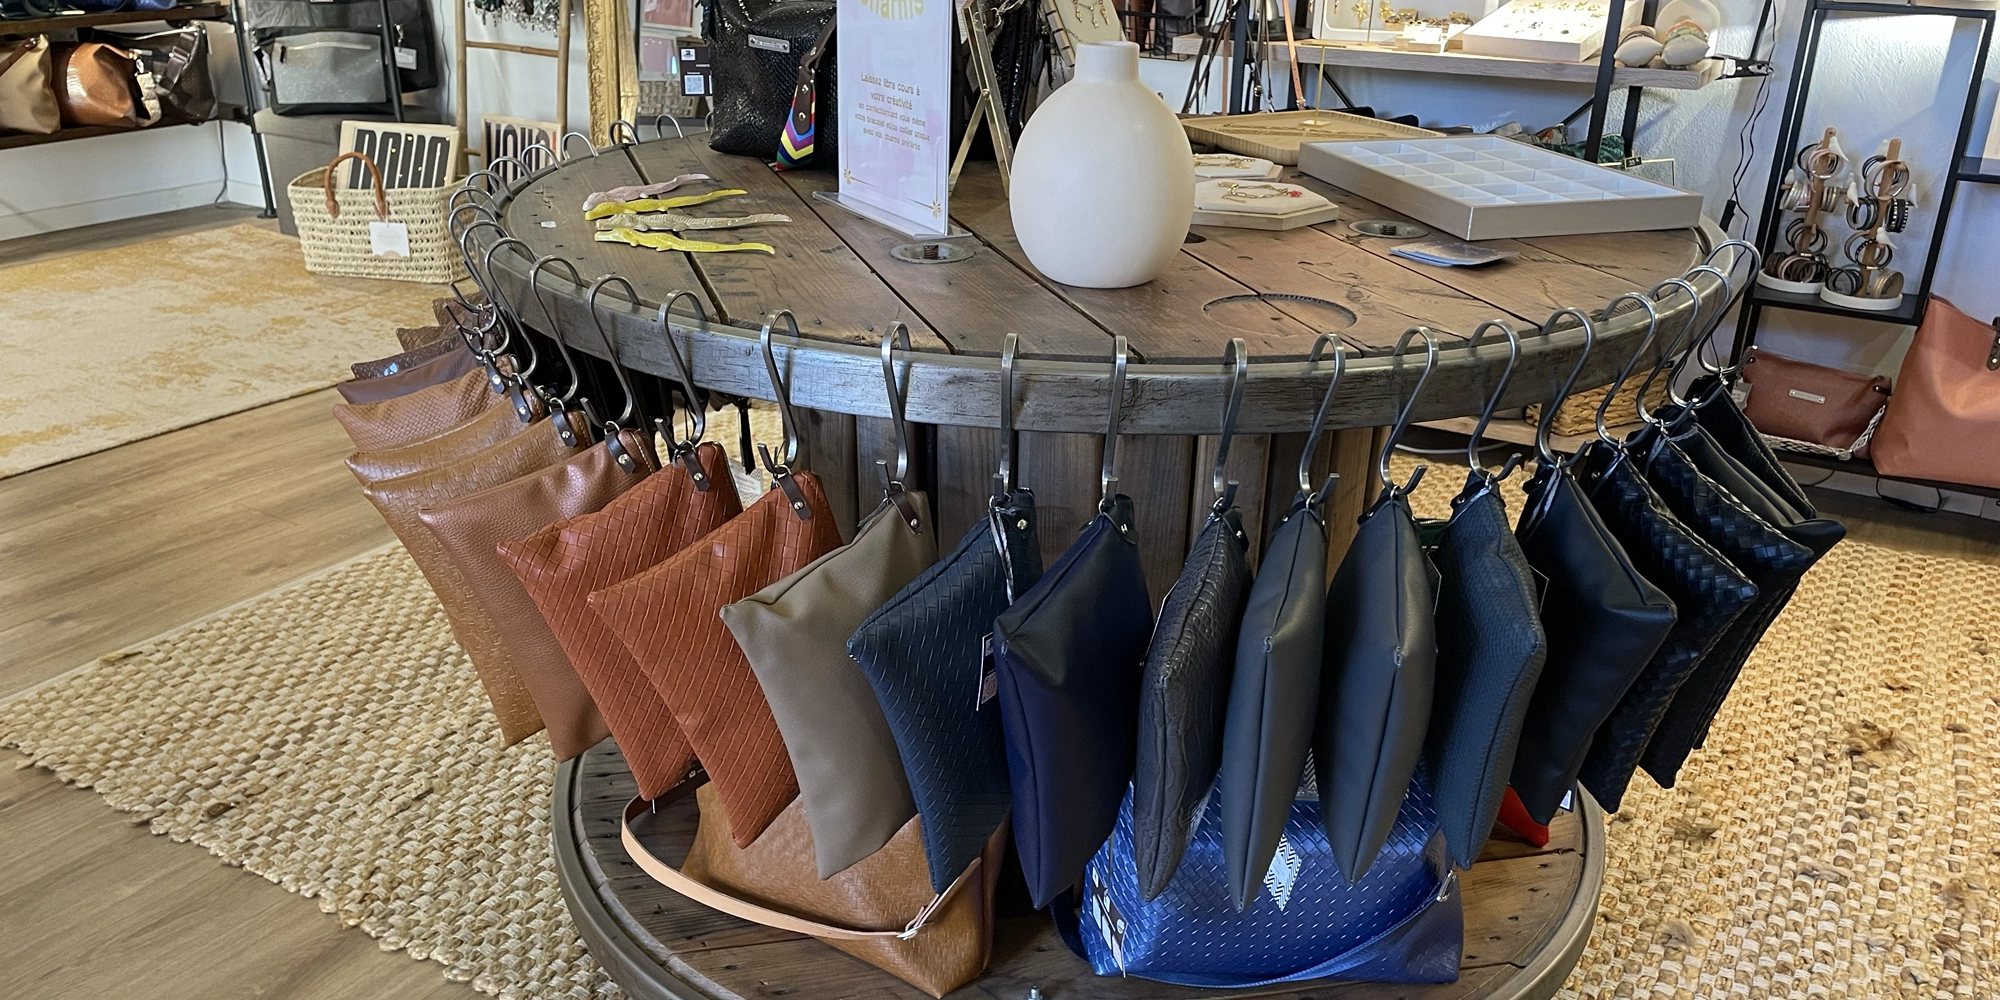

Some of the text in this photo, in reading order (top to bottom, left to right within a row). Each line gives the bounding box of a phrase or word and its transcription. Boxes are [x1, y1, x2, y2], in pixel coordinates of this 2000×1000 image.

[861, 72, 921, 96] Laissez libre cours à
[871, 92, 912, 110] votre créativité
